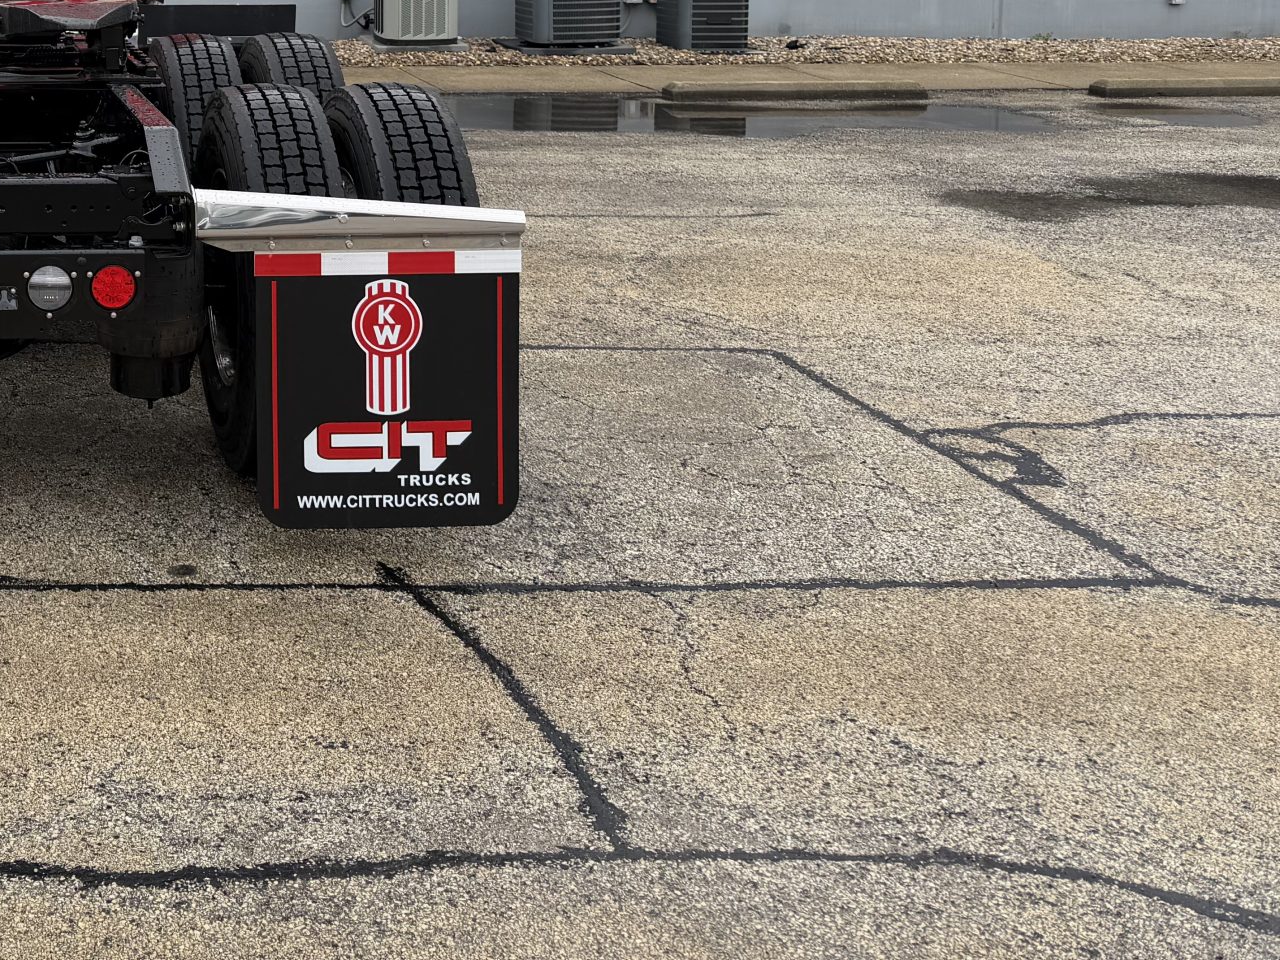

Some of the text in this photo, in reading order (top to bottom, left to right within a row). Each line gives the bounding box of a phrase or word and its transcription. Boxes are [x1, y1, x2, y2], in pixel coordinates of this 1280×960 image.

[304, 420, 472, 473] CIT
[397, 473, 471, 487] TRUCKS
[297, 492, 480, 510] WWW.CITTRUCKS.COM
